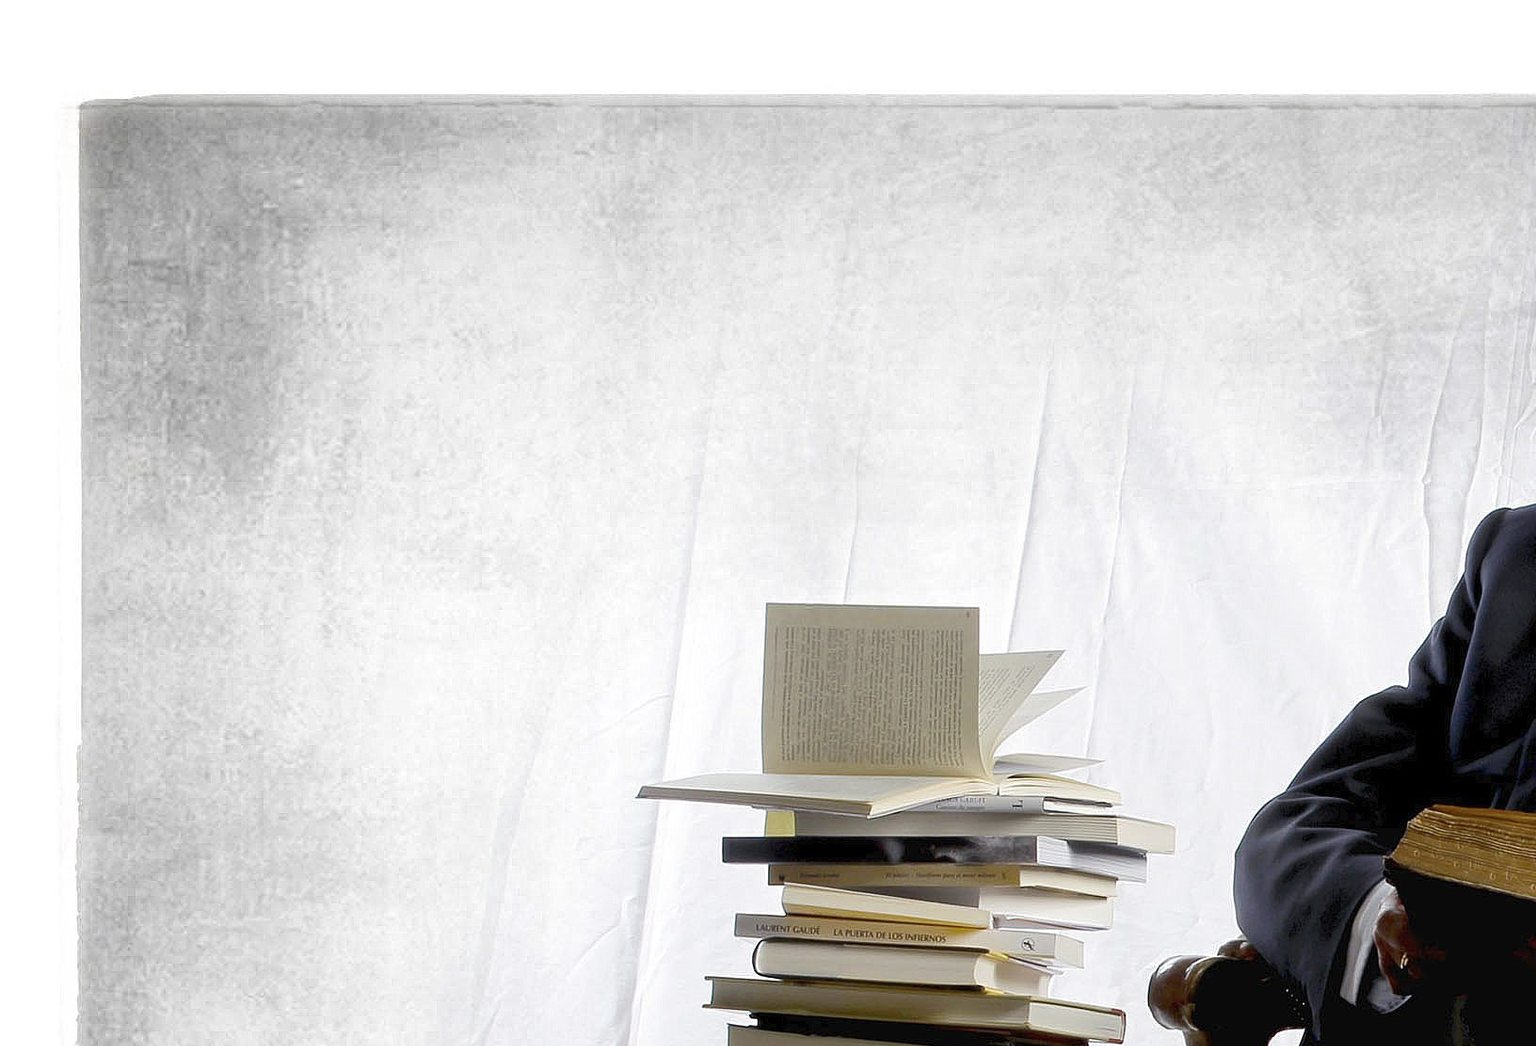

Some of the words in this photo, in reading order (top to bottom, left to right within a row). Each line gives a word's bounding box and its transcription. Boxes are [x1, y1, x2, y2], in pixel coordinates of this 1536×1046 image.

[756, 924, 791, 933] LAURENT
[793, 924, 820, 935] GAUDÉ
[833, 928, 843, 937] LA
[845, 929, 874, 938] PUERTA
[876, 931, 886, 939] DE
[888, 932, 903, 940] LOS
[905, 933, 947, 943] INFIERNOS
